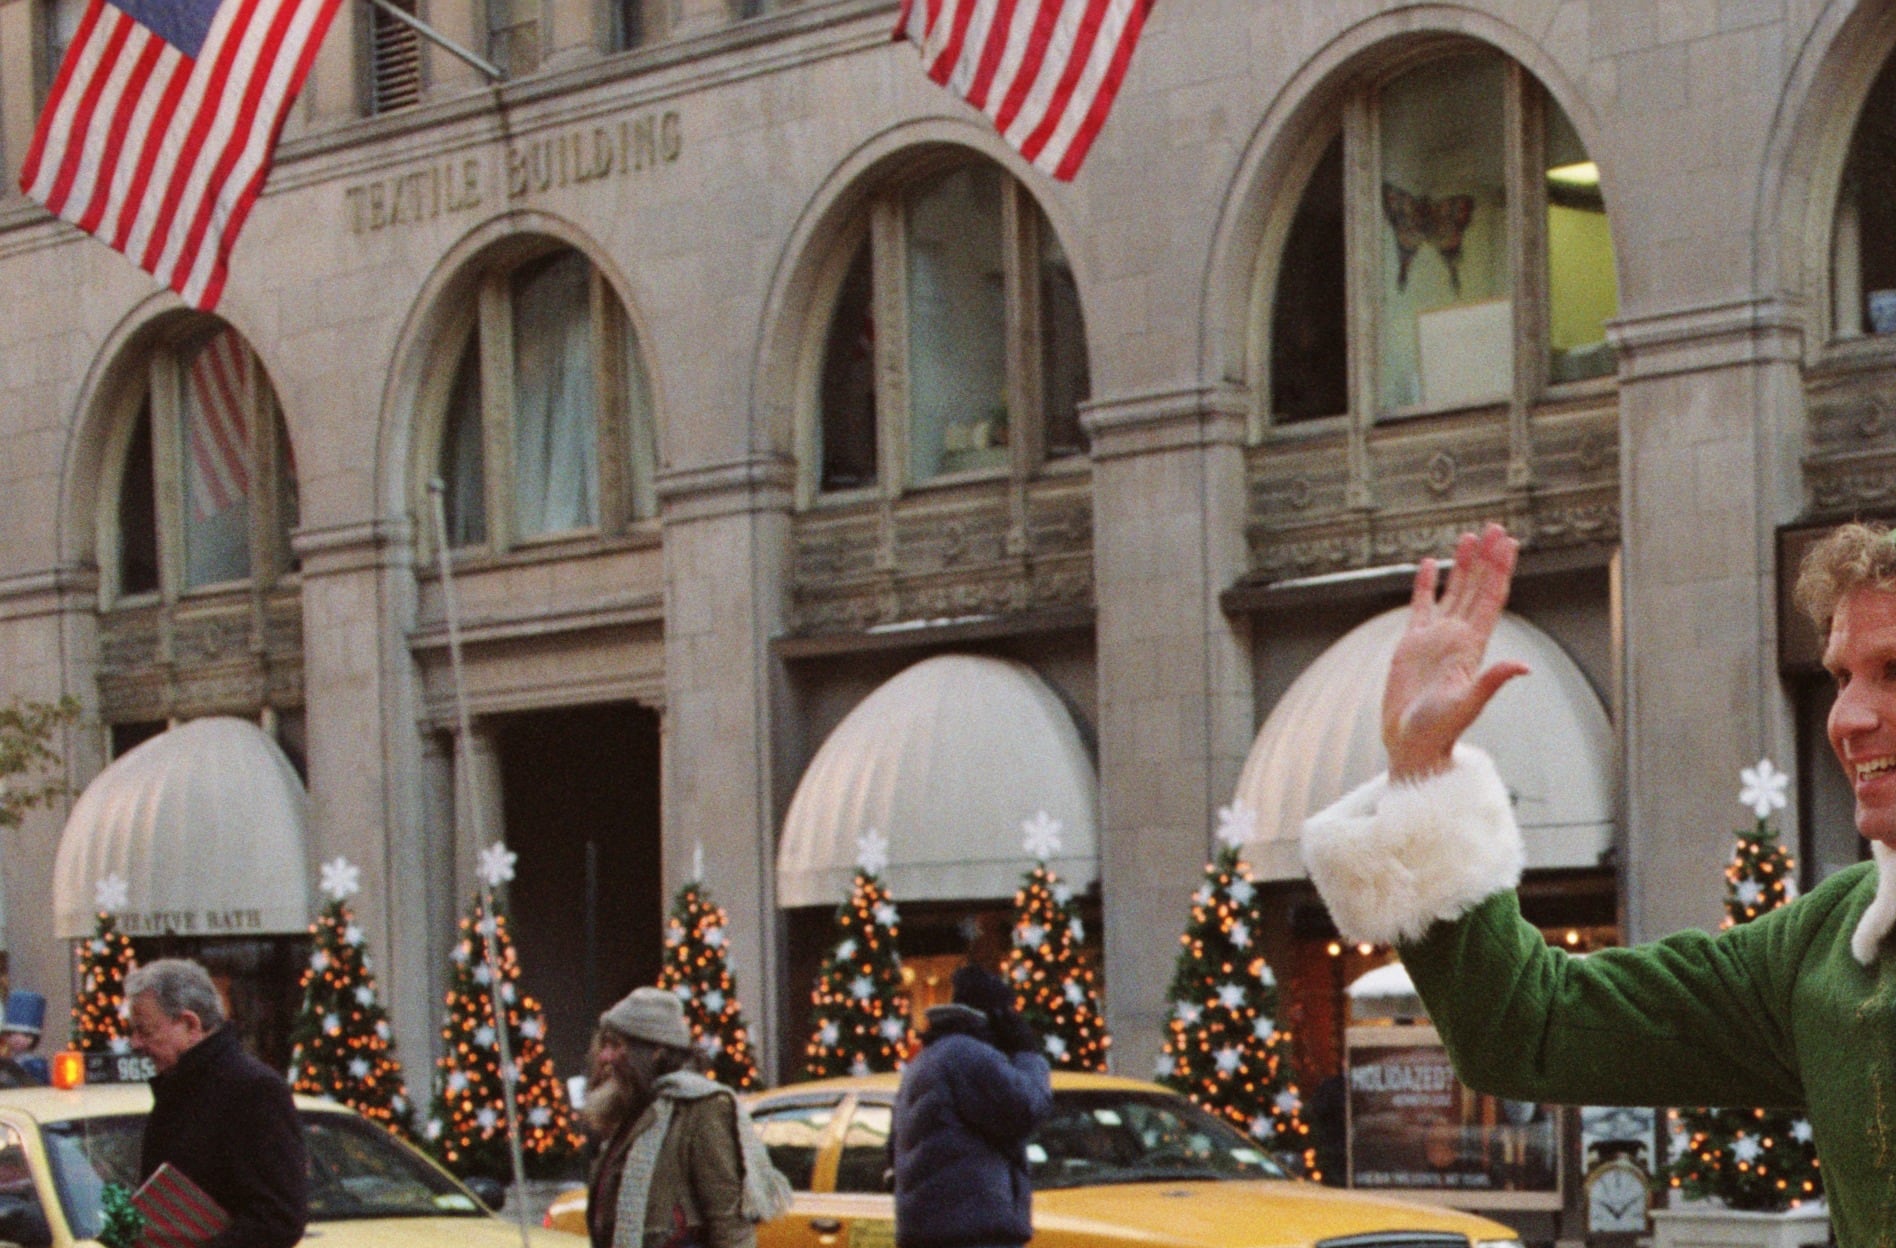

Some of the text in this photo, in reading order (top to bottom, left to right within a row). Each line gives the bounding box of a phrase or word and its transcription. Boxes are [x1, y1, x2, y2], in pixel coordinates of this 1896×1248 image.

[346, 110, 683, 234] TEXTILE BUILDING
[206, 909, 262, 929] BATH
